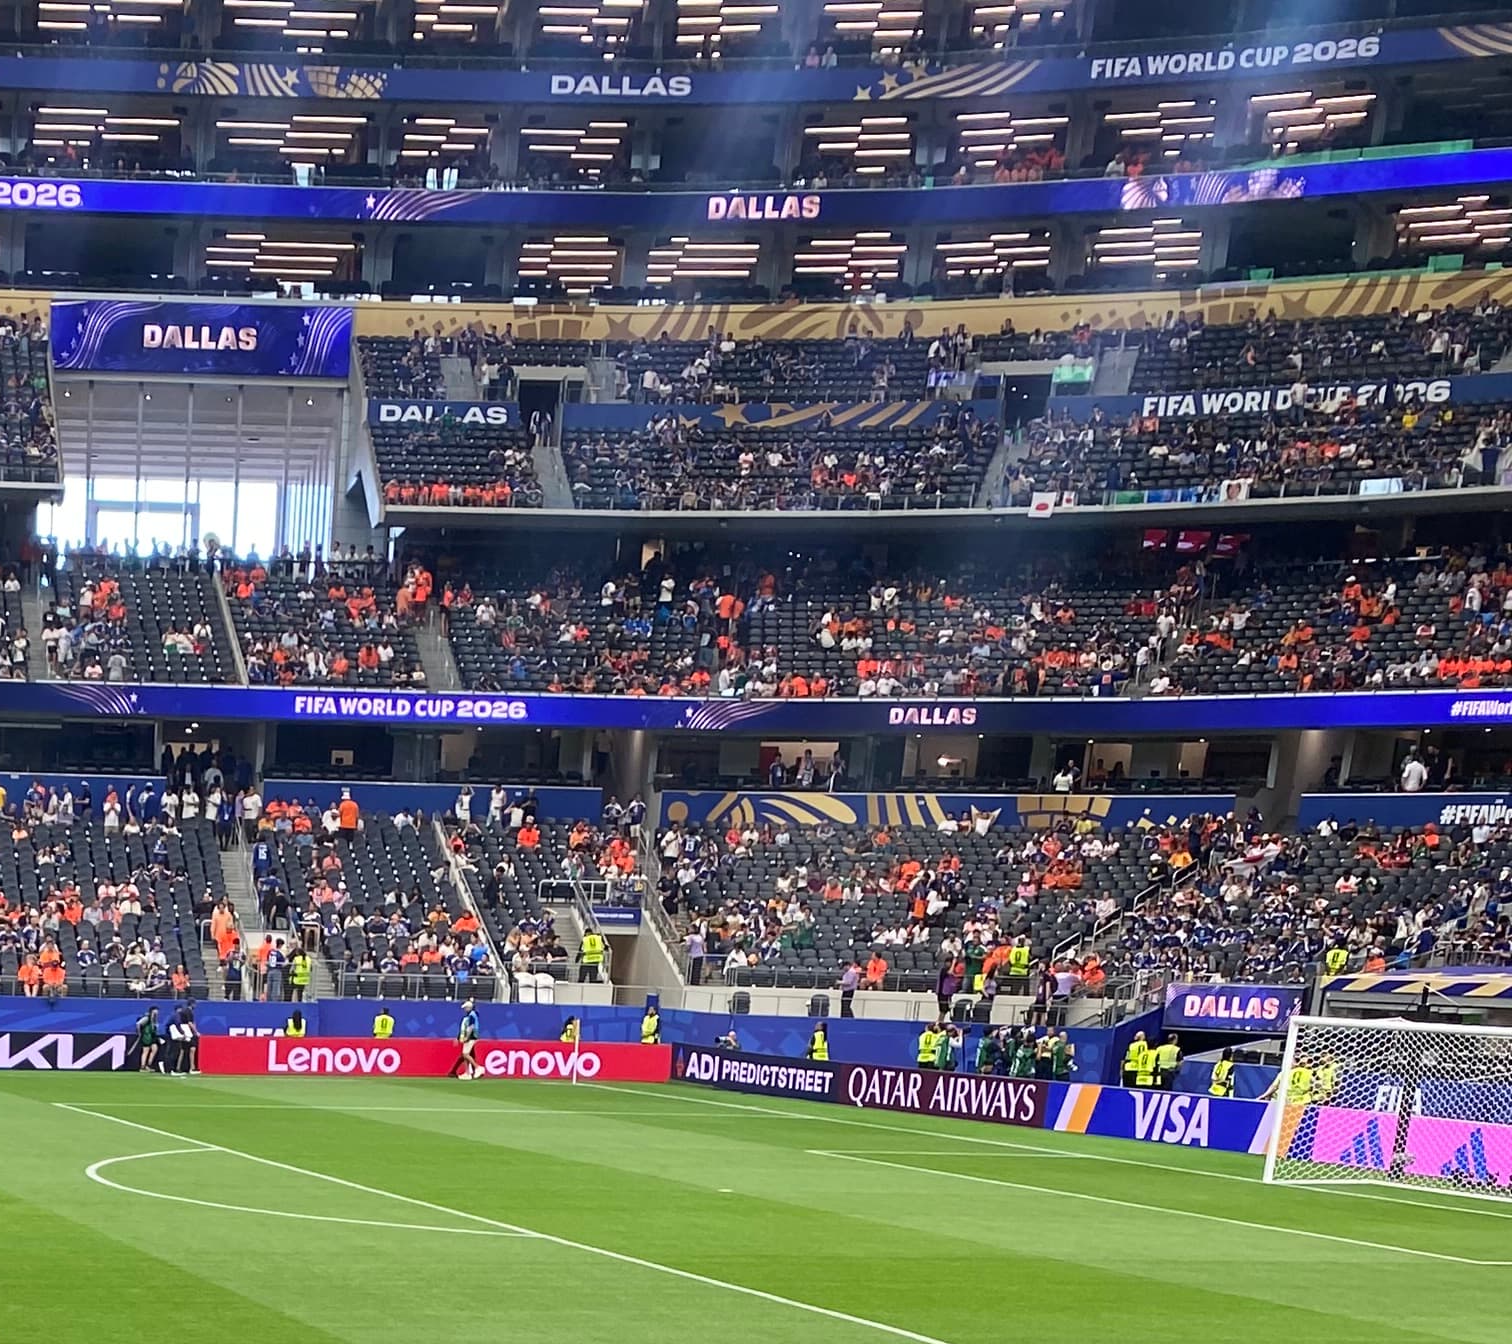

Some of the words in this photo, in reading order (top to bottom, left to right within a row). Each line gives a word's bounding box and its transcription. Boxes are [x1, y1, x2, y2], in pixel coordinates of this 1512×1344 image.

[1091, 57, 1141, 79] FIFA
[1145, 51, 1234, 75] WORLD
[1240, 46, 1289, 69] CUP
[1291, 35, 1381, 65] 2026
[550, 74, 692, 97] DALLAS
[707, 195, 821, 220] DALLAS
[142, 323, 258, 351] DALLAS
[1142, 393, 1196, 417] FIFA
[294, 696, 336, 716] FIFA
[340, 697, 409, 717] WORLD
[413, 698, 454, 718] CUP
[457, 699, 526, 719] 2026
[889, 706, 976, 726] DALLAS
[1451, 700, 1512, 716] #FIFAWorl
[1184, 995, 1280, 1019] DALLAS
[268, 1040, 401, 1074] Lenovo
[484, 1051, 601, 1077] enovo
[685, 1052, 720, 1082] ADI
[721, 1058, 834, 1094] PREDICTSTREET
[848, 1067, 922, 1109] QATAR
[929, 1074, 1038, 1123] AIRWAYS
[1375, 1085, 1422, 1116] FIA
[1129, 1091, 1210, 1147] VISA
